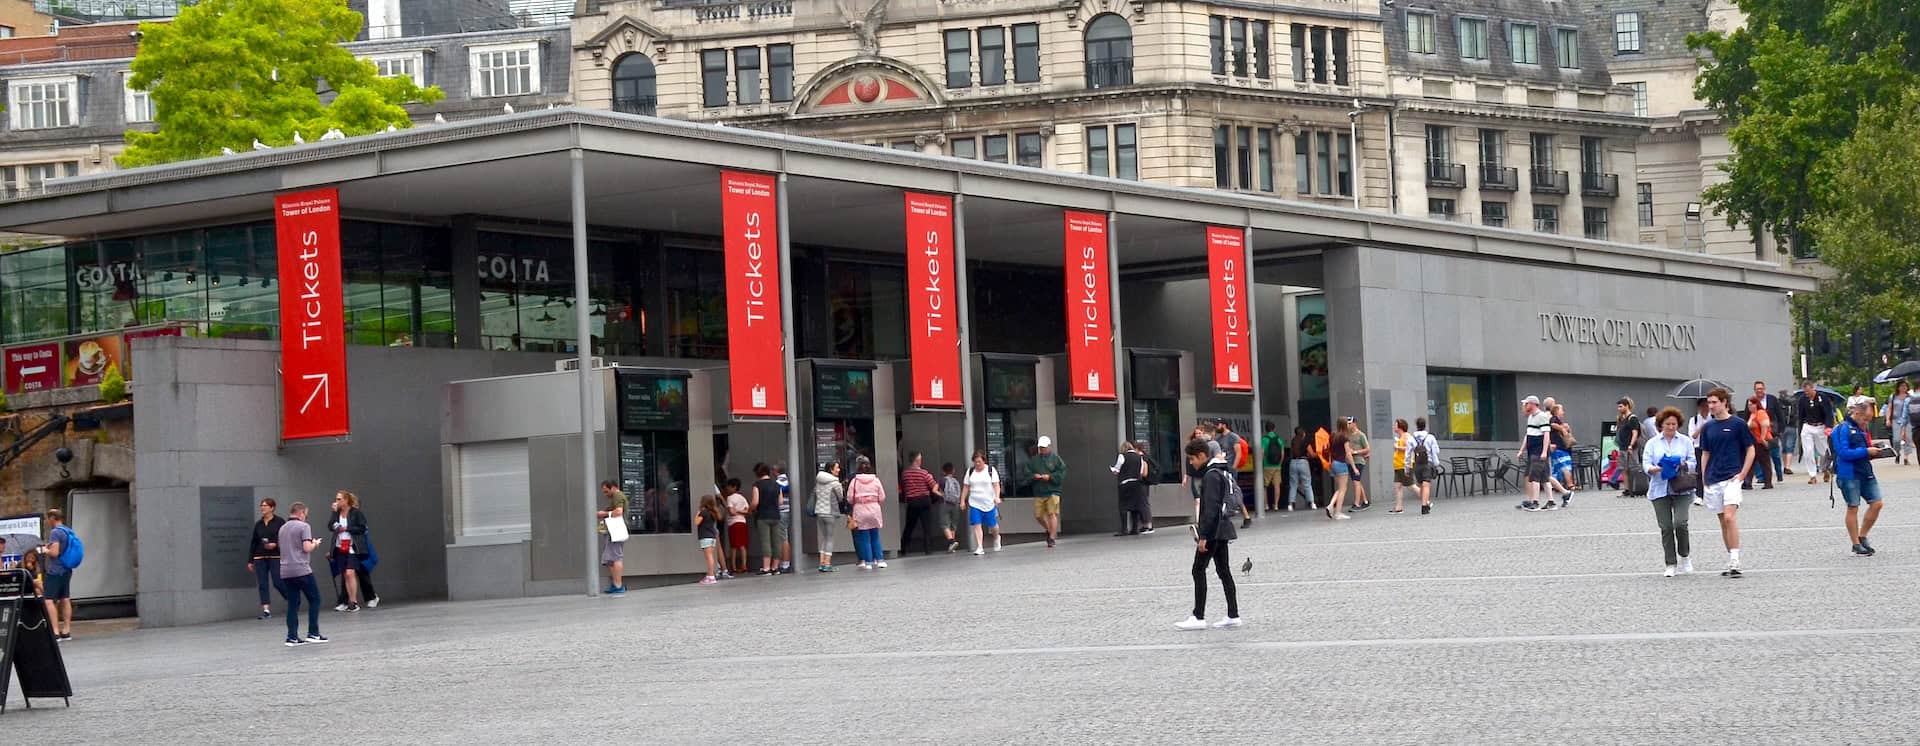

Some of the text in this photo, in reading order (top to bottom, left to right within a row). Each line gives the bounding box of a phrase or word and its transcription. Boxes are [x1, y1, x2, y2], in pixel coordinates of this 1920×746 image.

[728, 186, 744, 194] Tower
[751, 188, 770, 197] London
[308, 205, 331, 213] London
[911, 206, 926, 214] Tower
[931, 208, 947, 217] London
[1070, 223, 1082, 231] Tower
[1088, 225, 1102, 233] London
[76, 262, 142, 287] COSTA
[477, 255, 550, 283] COSTA
[744, 212, 764, 327] Tickets
[300, 231, 322, 349] Tickets
[925, 231, 942, 337] Tickets
[1081, 247, 1099, 347] Tickets
[1223, 259, 1239, 353] Tickets
[1537, 311, 1697, 351] TOWER OF LONDON
[11, 353, 23, 362] This
[23, 353, 33, 361] way
[33, 351, 39, 359] to
[24, 381, 42, 390] COSTA
